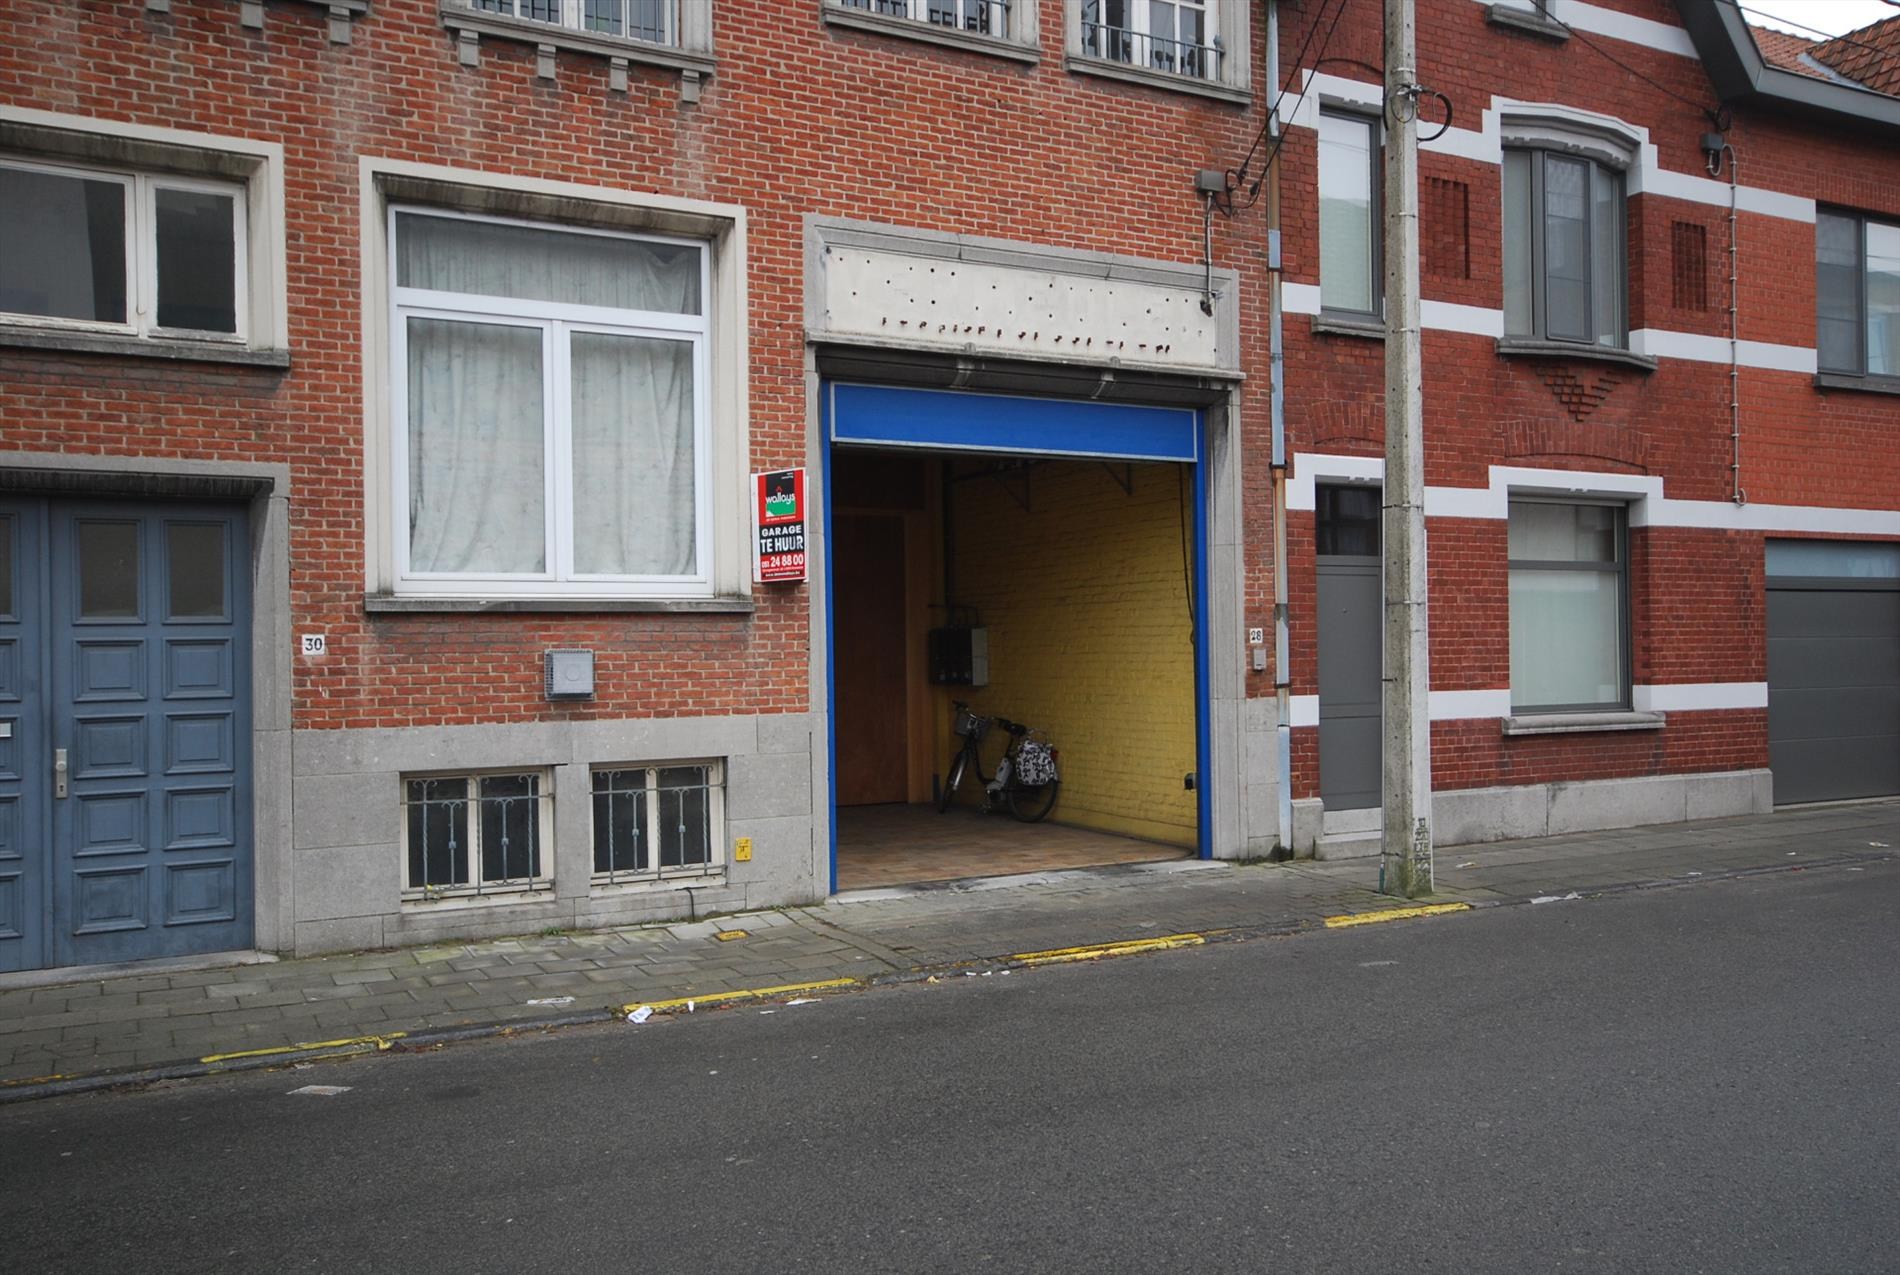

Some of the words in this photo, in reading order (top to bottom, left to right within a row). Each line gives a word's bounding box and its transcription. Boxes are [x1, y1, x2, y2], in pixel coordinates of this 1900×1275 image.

[762, 525, 801, 537] GARAGE
[761, 539, 773, 553] TE
[775, 535, 803, 551] HUUR
[770, 556, 780, 568] 24
[782, 555, 792, 566] 88
[793, 554, 803, 565] 00
[1251, 630, 1261, 640] 28
[305, 638, 322, 651] 30
